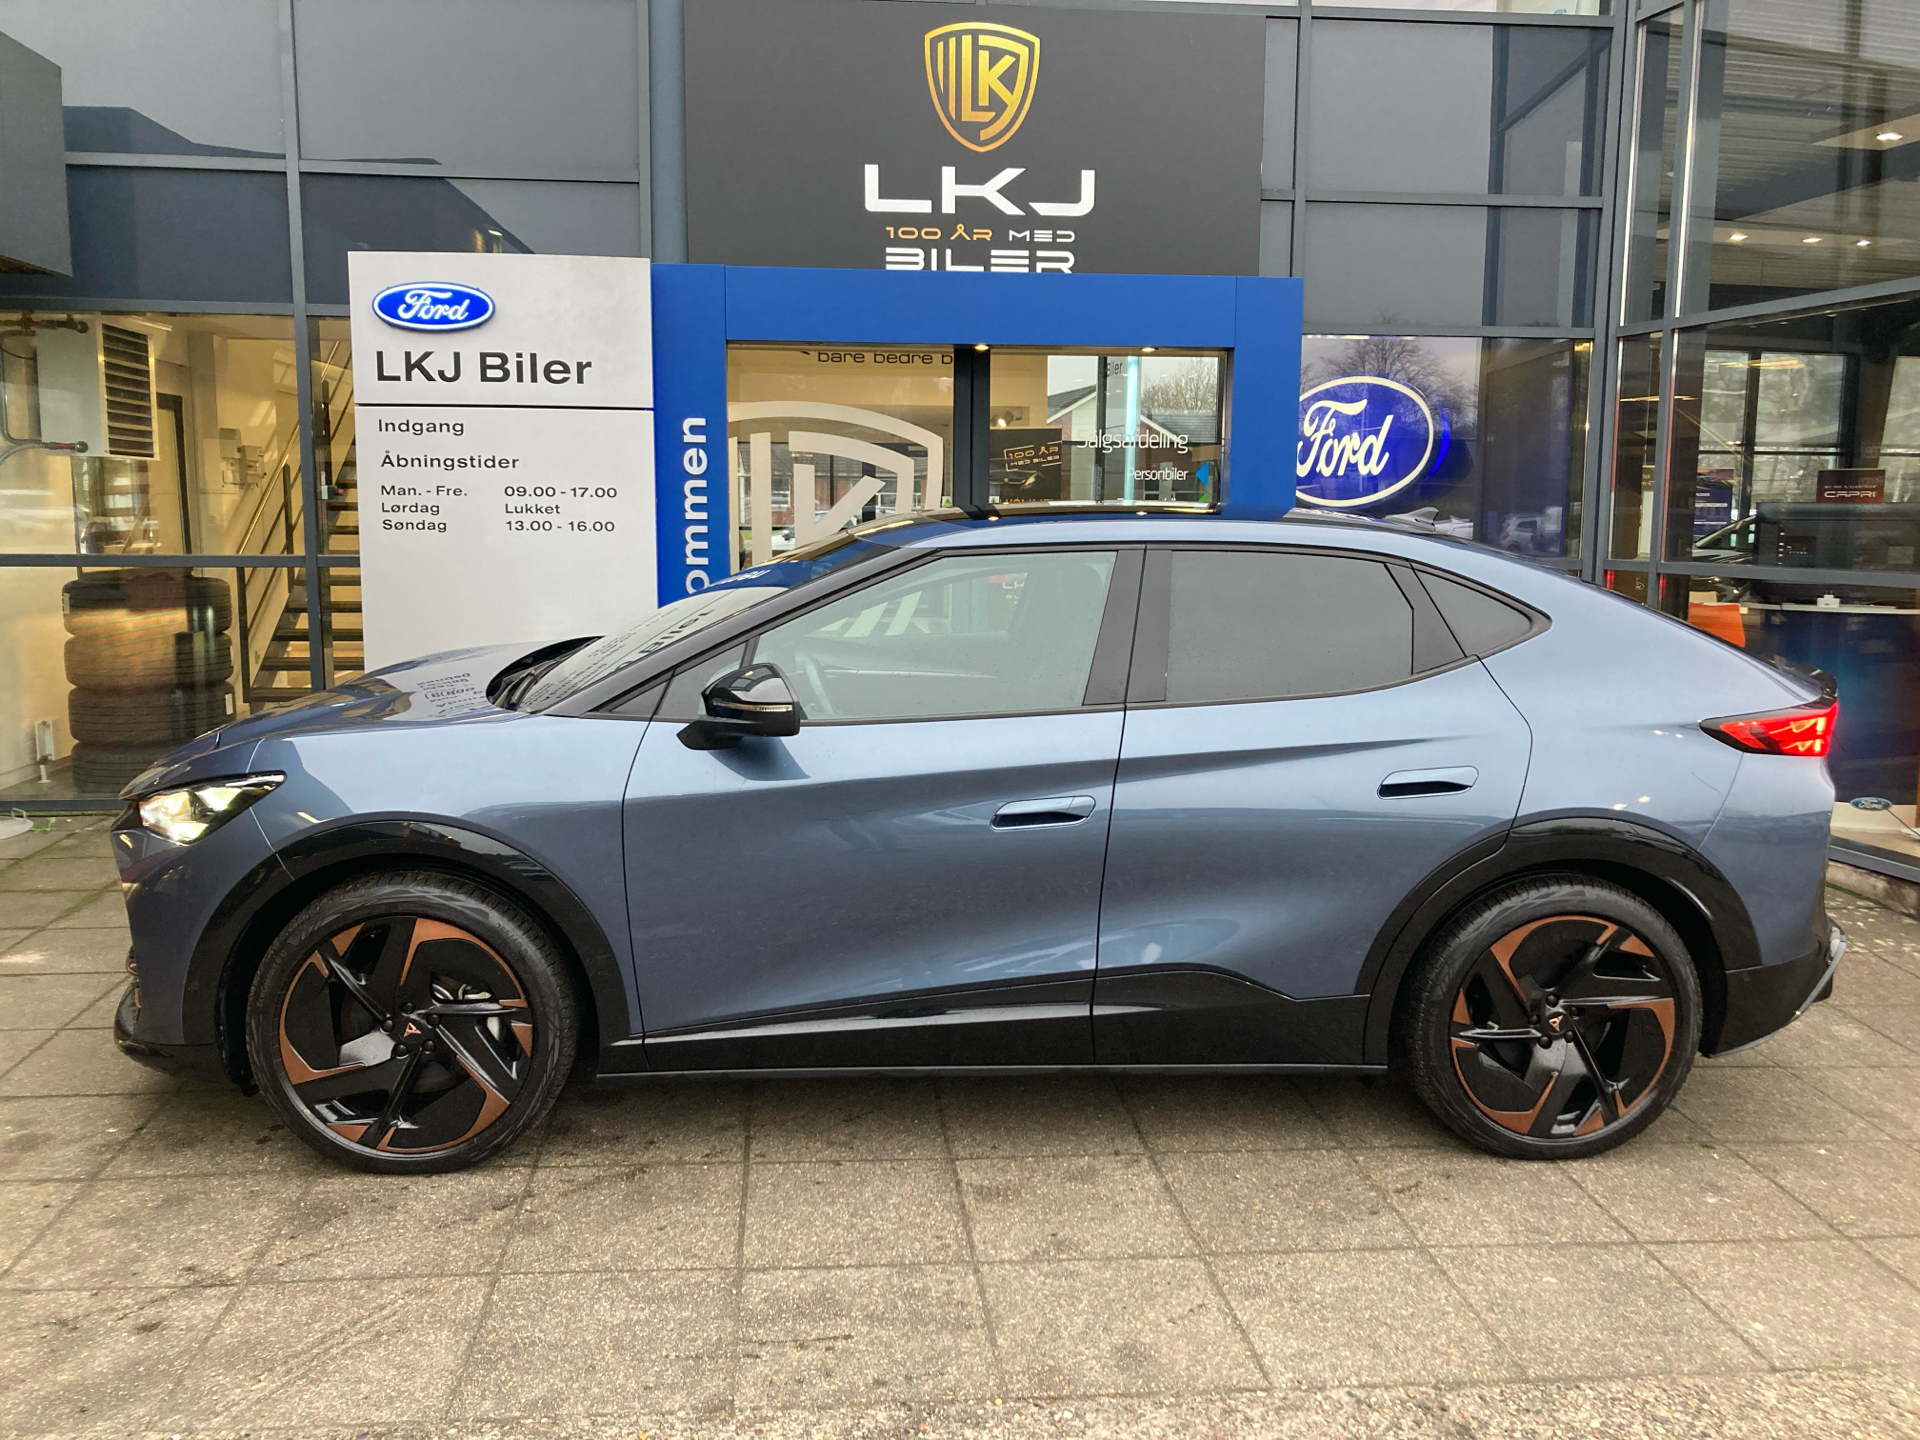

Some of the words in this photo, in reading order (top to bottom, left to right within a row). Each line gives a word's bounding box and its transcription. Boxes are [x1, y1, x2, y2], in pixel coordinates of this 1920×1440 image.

[865, 163, 1095, 216] LKJ
[885, 226, 942, 240] 100
[950, 223, 993, 241] ÅR
[1009, 229, 1076, 243] MED
[885, 247, 1075, 273] BILER
[397, 288, 470, 321] Ford
[376, 350, 461, 383] LKJ
[479, 351, 592, 385] Biler
[817, 352, 865, 363] bare
[873, 353, 933, 365] bedre
[378, 418, 465, 437] Indgang
[1297, 398, 1394, 478] Ford
[380, 450, 520, 472] Åbningstider
[1008, 449, 1035, 460] 100
[1128, 467, 1189, 480] Personbiler
[380, 484, 422, 497] Man.
[436, 485, 468, 497] Fre.
[504, 486, 556, 498] 09.00
[570, 487, 618, 498] 17.00
[1823, 490, 1876, 498] CAPRI
[381, 502, 441, 516] Lørdag
[505, 503, 561, 515] Lukket
[382, 519, 447, 533] Søndag
[506, 520, 553, 532] 13.00
[568, 521, 615, 532] 16.00
